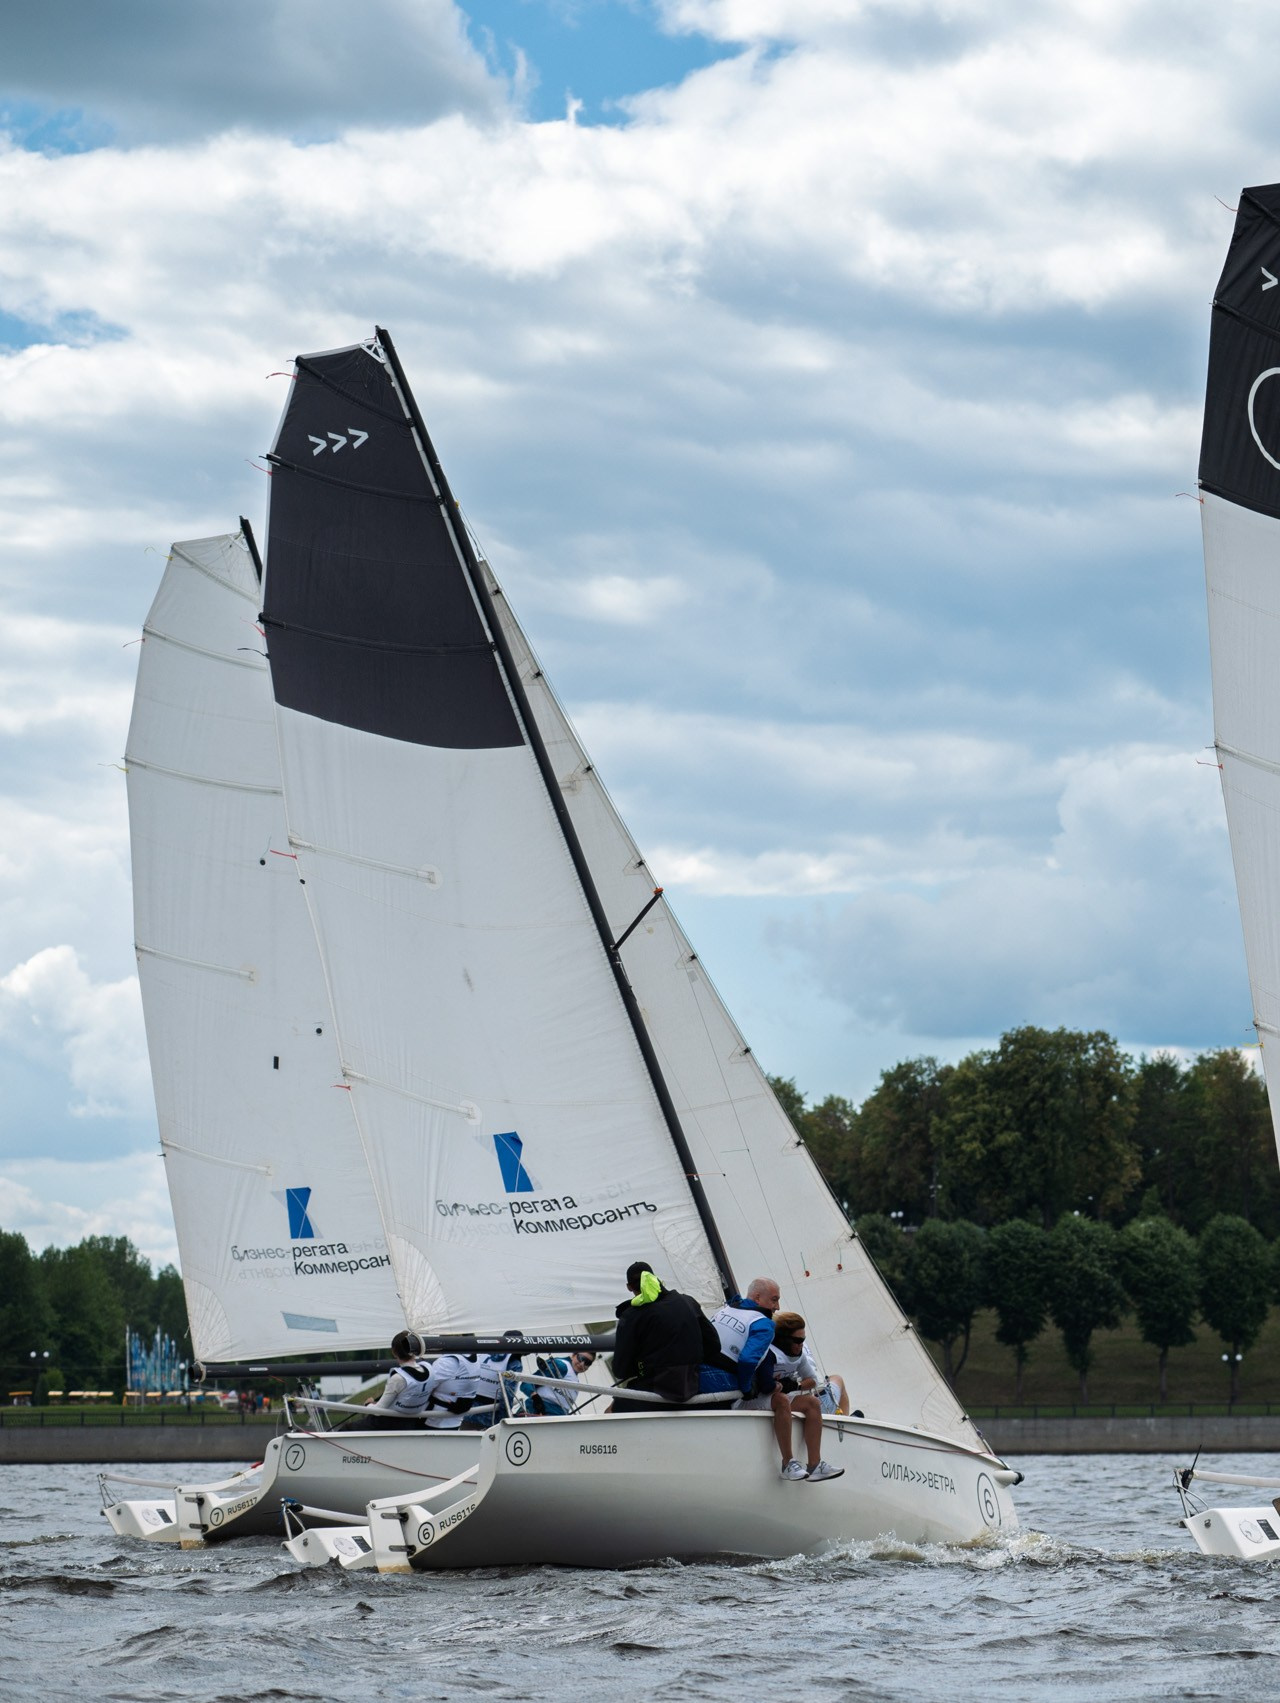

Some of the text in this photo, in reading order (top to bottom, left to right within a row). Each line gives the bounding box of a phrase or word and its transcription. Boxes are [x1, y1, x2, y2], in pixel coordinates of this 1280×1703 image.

[513, 1201, 658, 1234] Коммерсантъ
[293, 1254, 391, 1275] Коммерсан
[523, 1336, 592, 1345] SILAVETRA.COM
[292, 1450, 300, 1464] 7
[513, 1440, 524, 1458] 6
[579, 1444, 618, 1455] RUS6116
[342, 1455, 371, 1464] RUS6117
[881, 1461, 956, 1495] СИЛА ВЕТРА
[227, 1496, 258, 1516] RUS6117
[983, 1488, 994, 1519] 6
[213, 1512, 221, 1522] 7
[422, 1528, 431, 1540] 6
